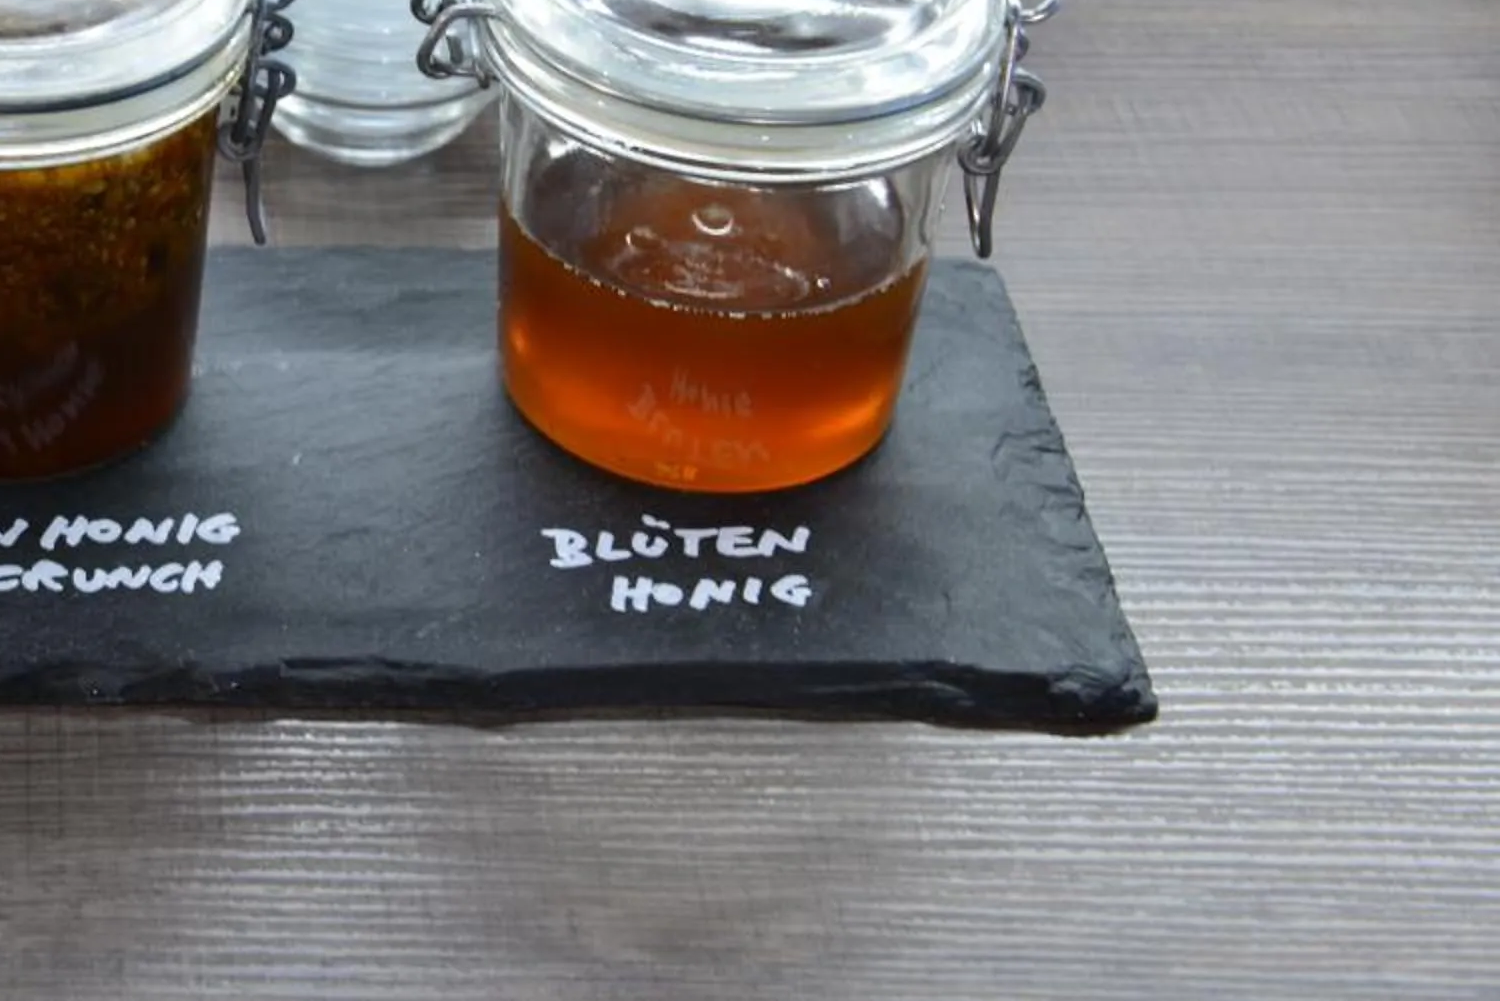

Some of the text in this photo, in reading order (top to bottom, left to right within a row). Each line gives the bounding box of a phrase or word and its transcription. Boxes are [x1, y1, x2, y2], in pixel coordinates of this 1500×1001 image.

[40, 512, 241, 550] HONIG
[541, 513, 810, 568] BLÜTEN
[610, 574, 812, 612] HONIG
